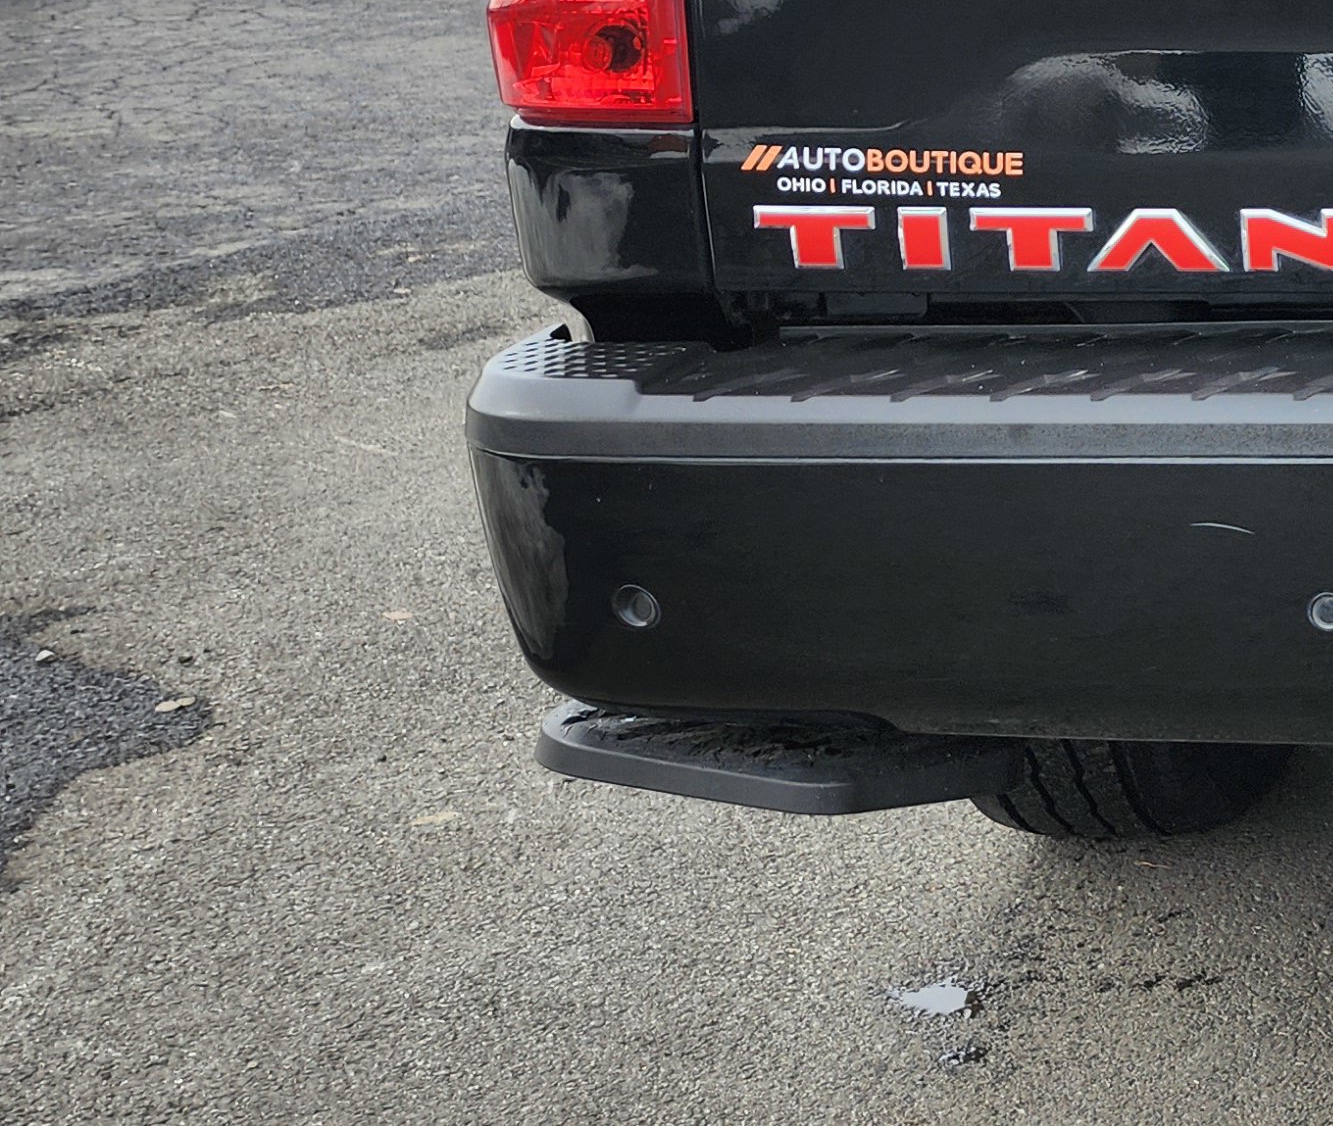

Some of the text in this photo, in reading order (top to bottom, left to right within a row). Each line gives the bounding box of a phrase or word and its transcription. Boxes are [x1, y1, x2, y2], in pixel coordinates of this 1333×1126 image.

[776, 145, 1024, 176] AUTOBOUTIQUE
[776, 177, 1002, 198] OHIO FLORIDA TEXAS
